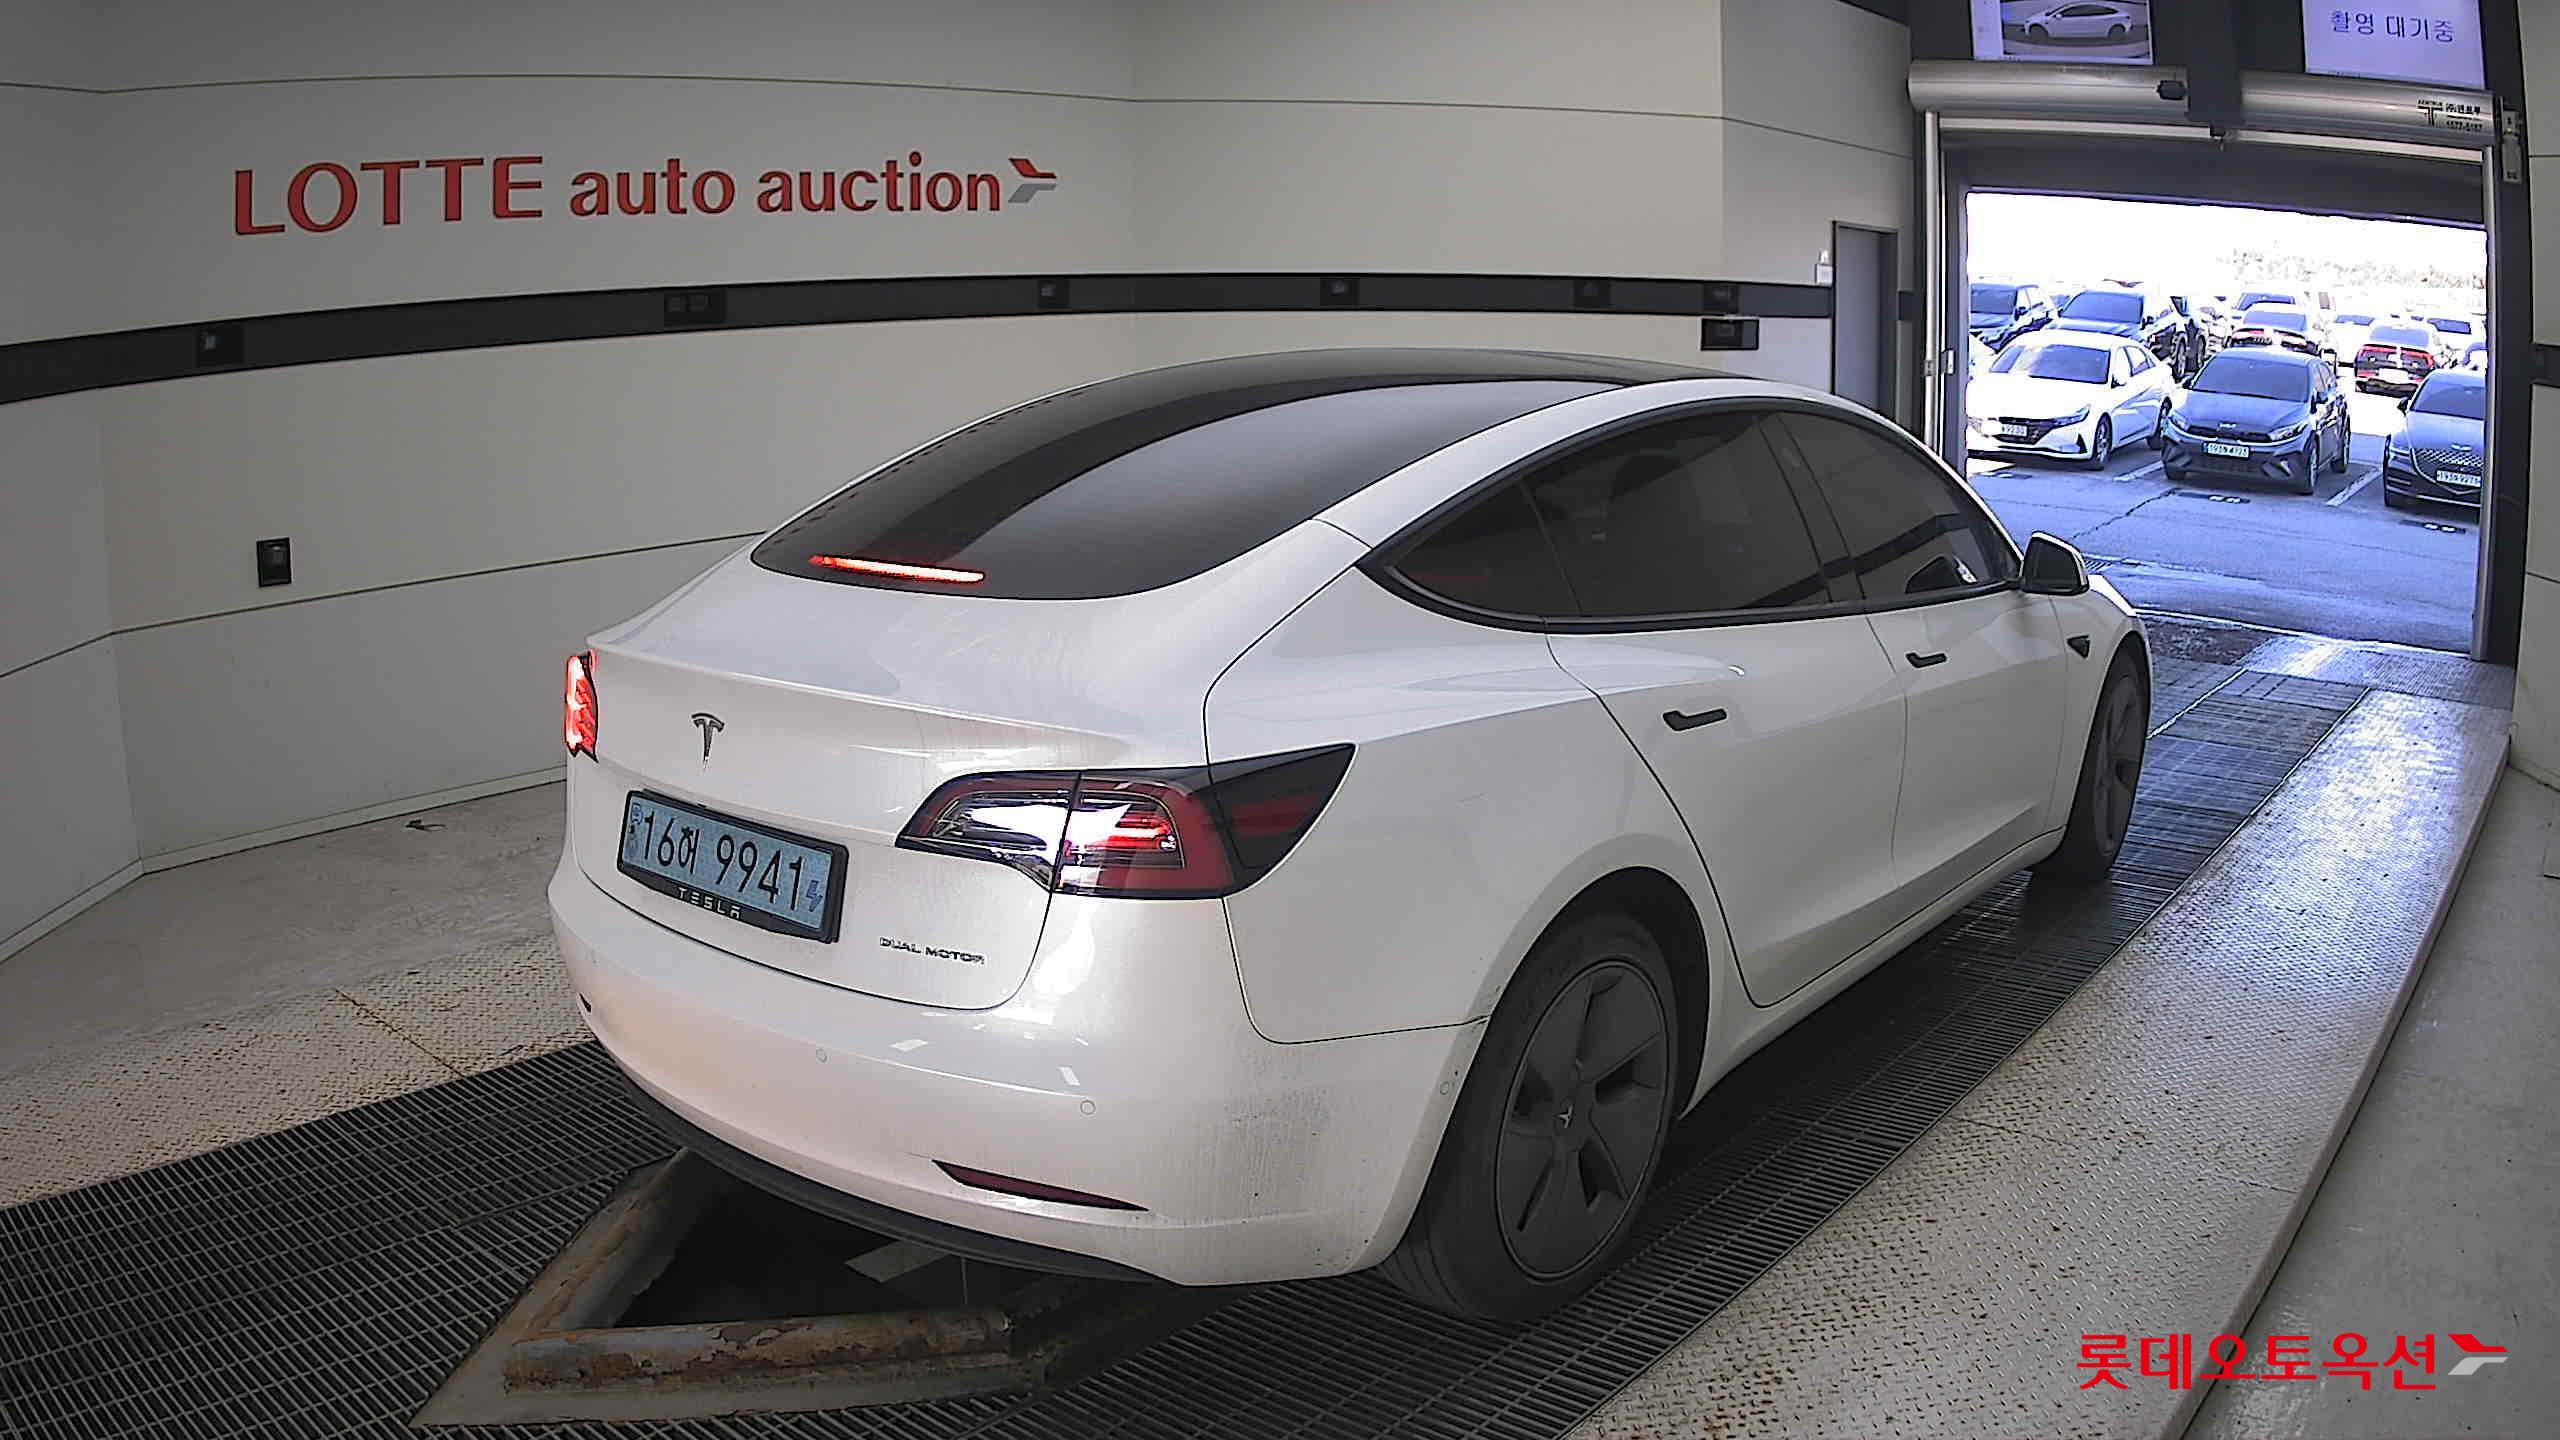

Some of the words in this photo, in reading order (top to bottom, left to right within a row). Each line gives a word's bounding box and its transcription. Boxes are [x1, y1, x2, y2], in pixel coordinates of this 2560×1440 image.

[2331, 10, 2374, 35] 촬영
[2386, 15, 2454, 43] 대기중
[235, 156, 543, 235] LOTTE
[570, 158, 735, 216] auto
[757, 151, 1000, 212] auction
[716, 834, 804, 911] 9941
[677, 887, 741, 919] TESLA
[880, 937, 921, 954] DUAL
[925, 946, 985, 965] MOTOR
